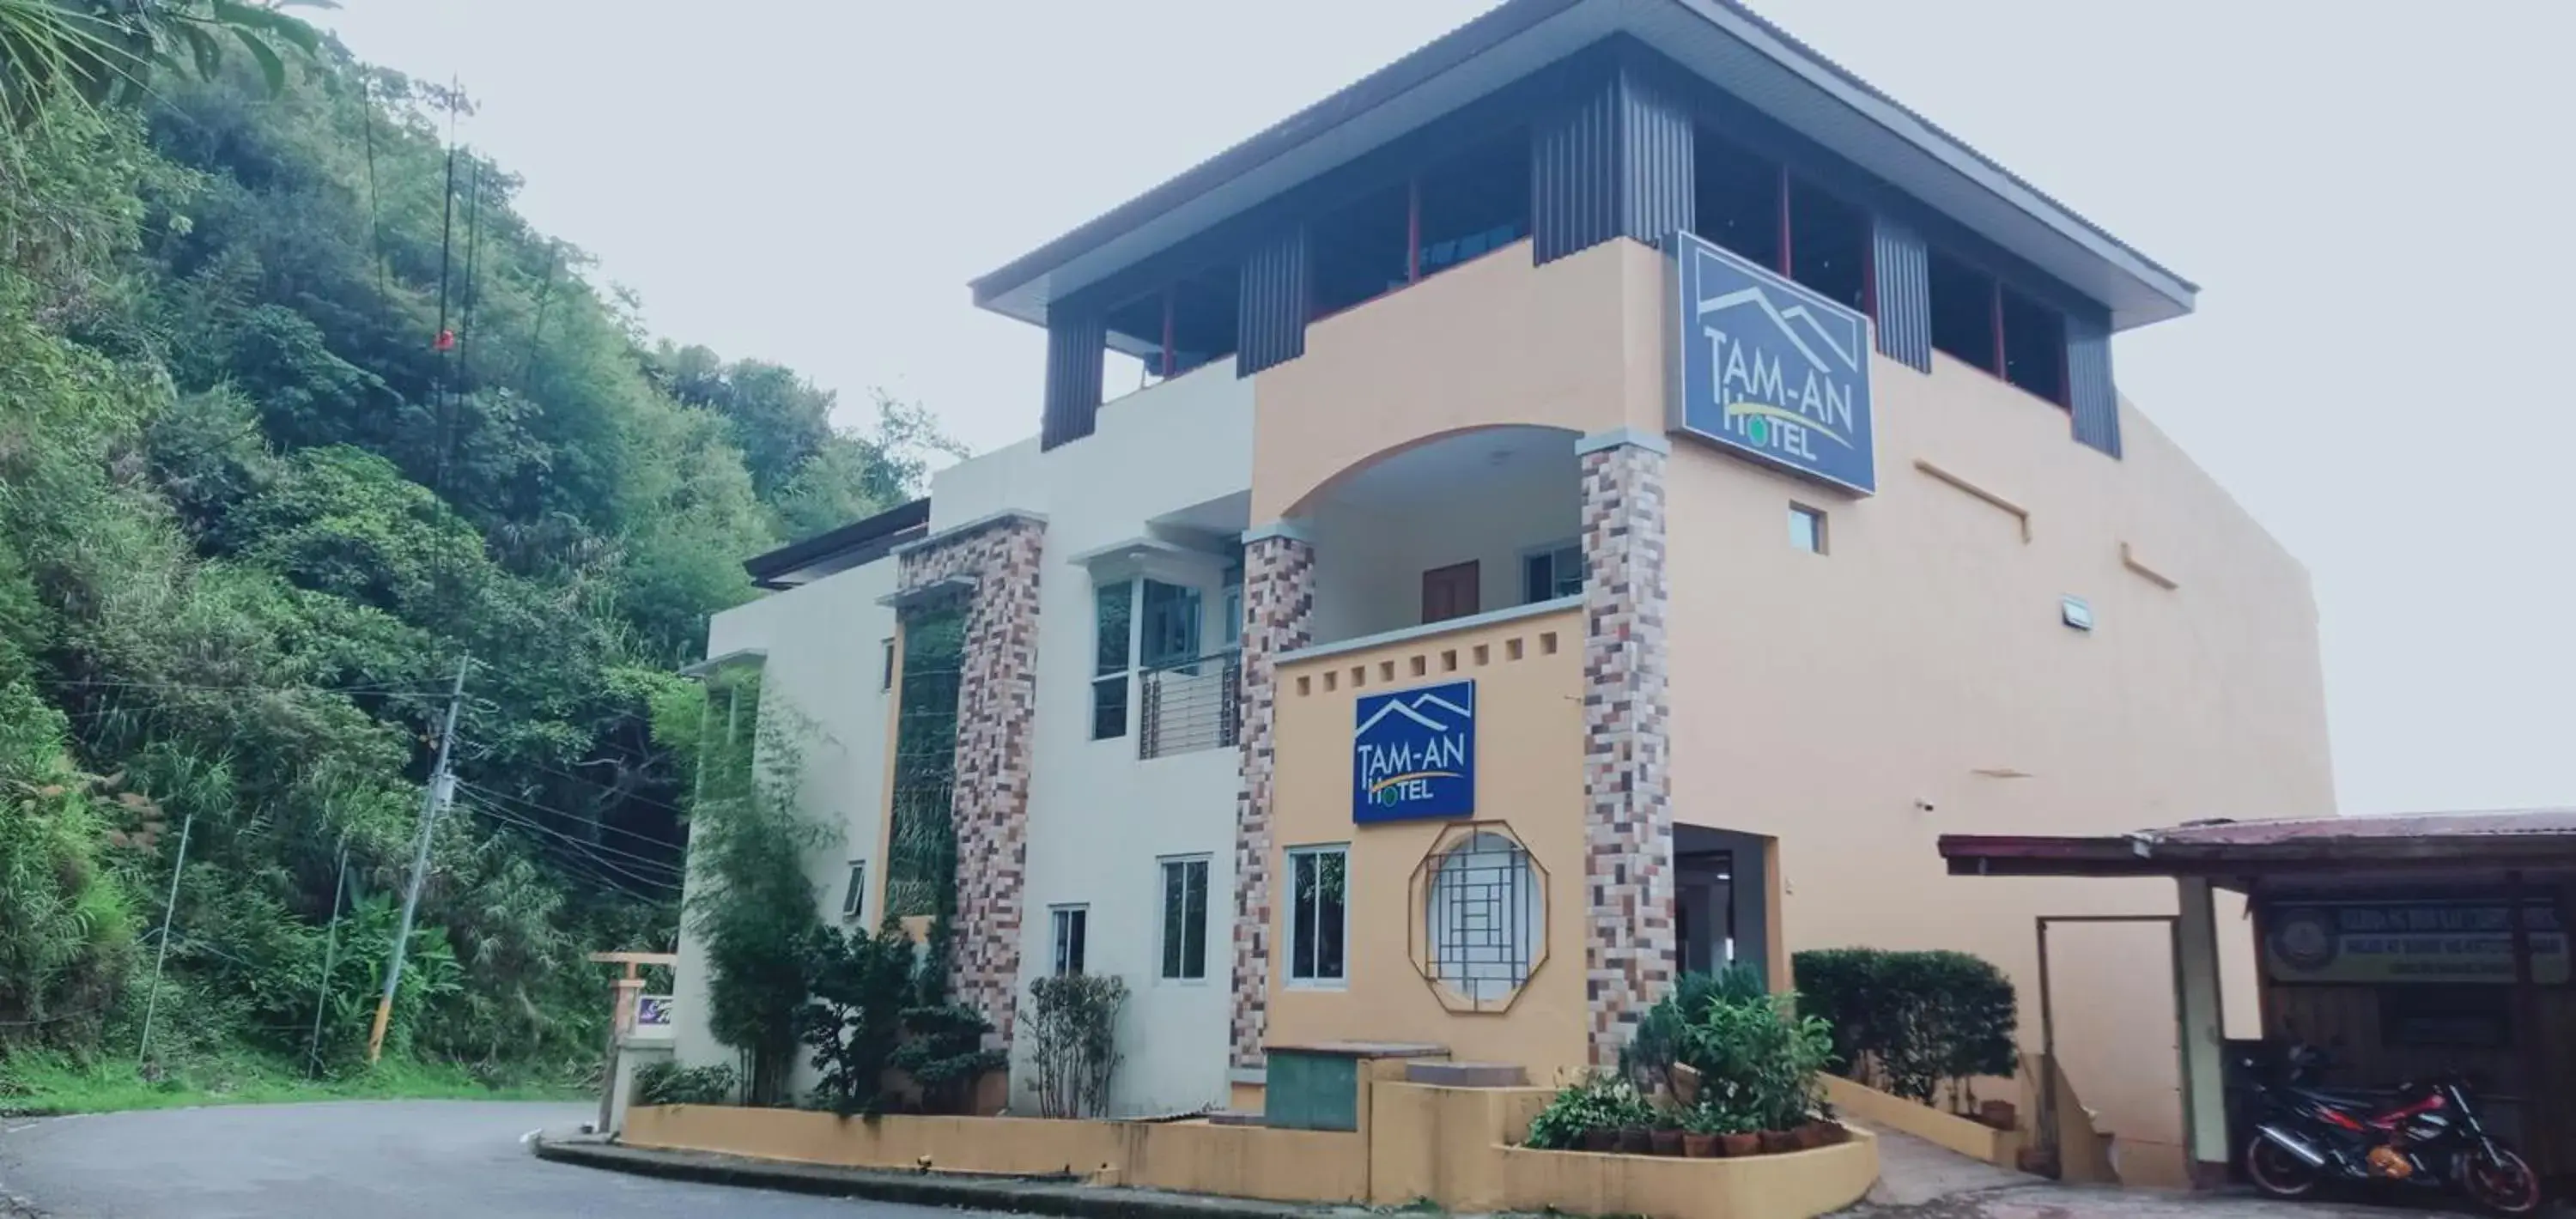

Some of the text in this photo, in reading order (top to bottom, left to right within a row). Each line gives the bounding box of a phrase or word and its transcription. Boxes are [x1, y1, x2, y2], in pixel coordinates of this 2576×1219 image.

[1704, 325, 1853, 434] TAM-AN
[1723, 386, 1817, 461] HOTEL
[1358, 731, 1464, 791] TAM-AN
[1368, 776, 1434, 808] HOTEL
